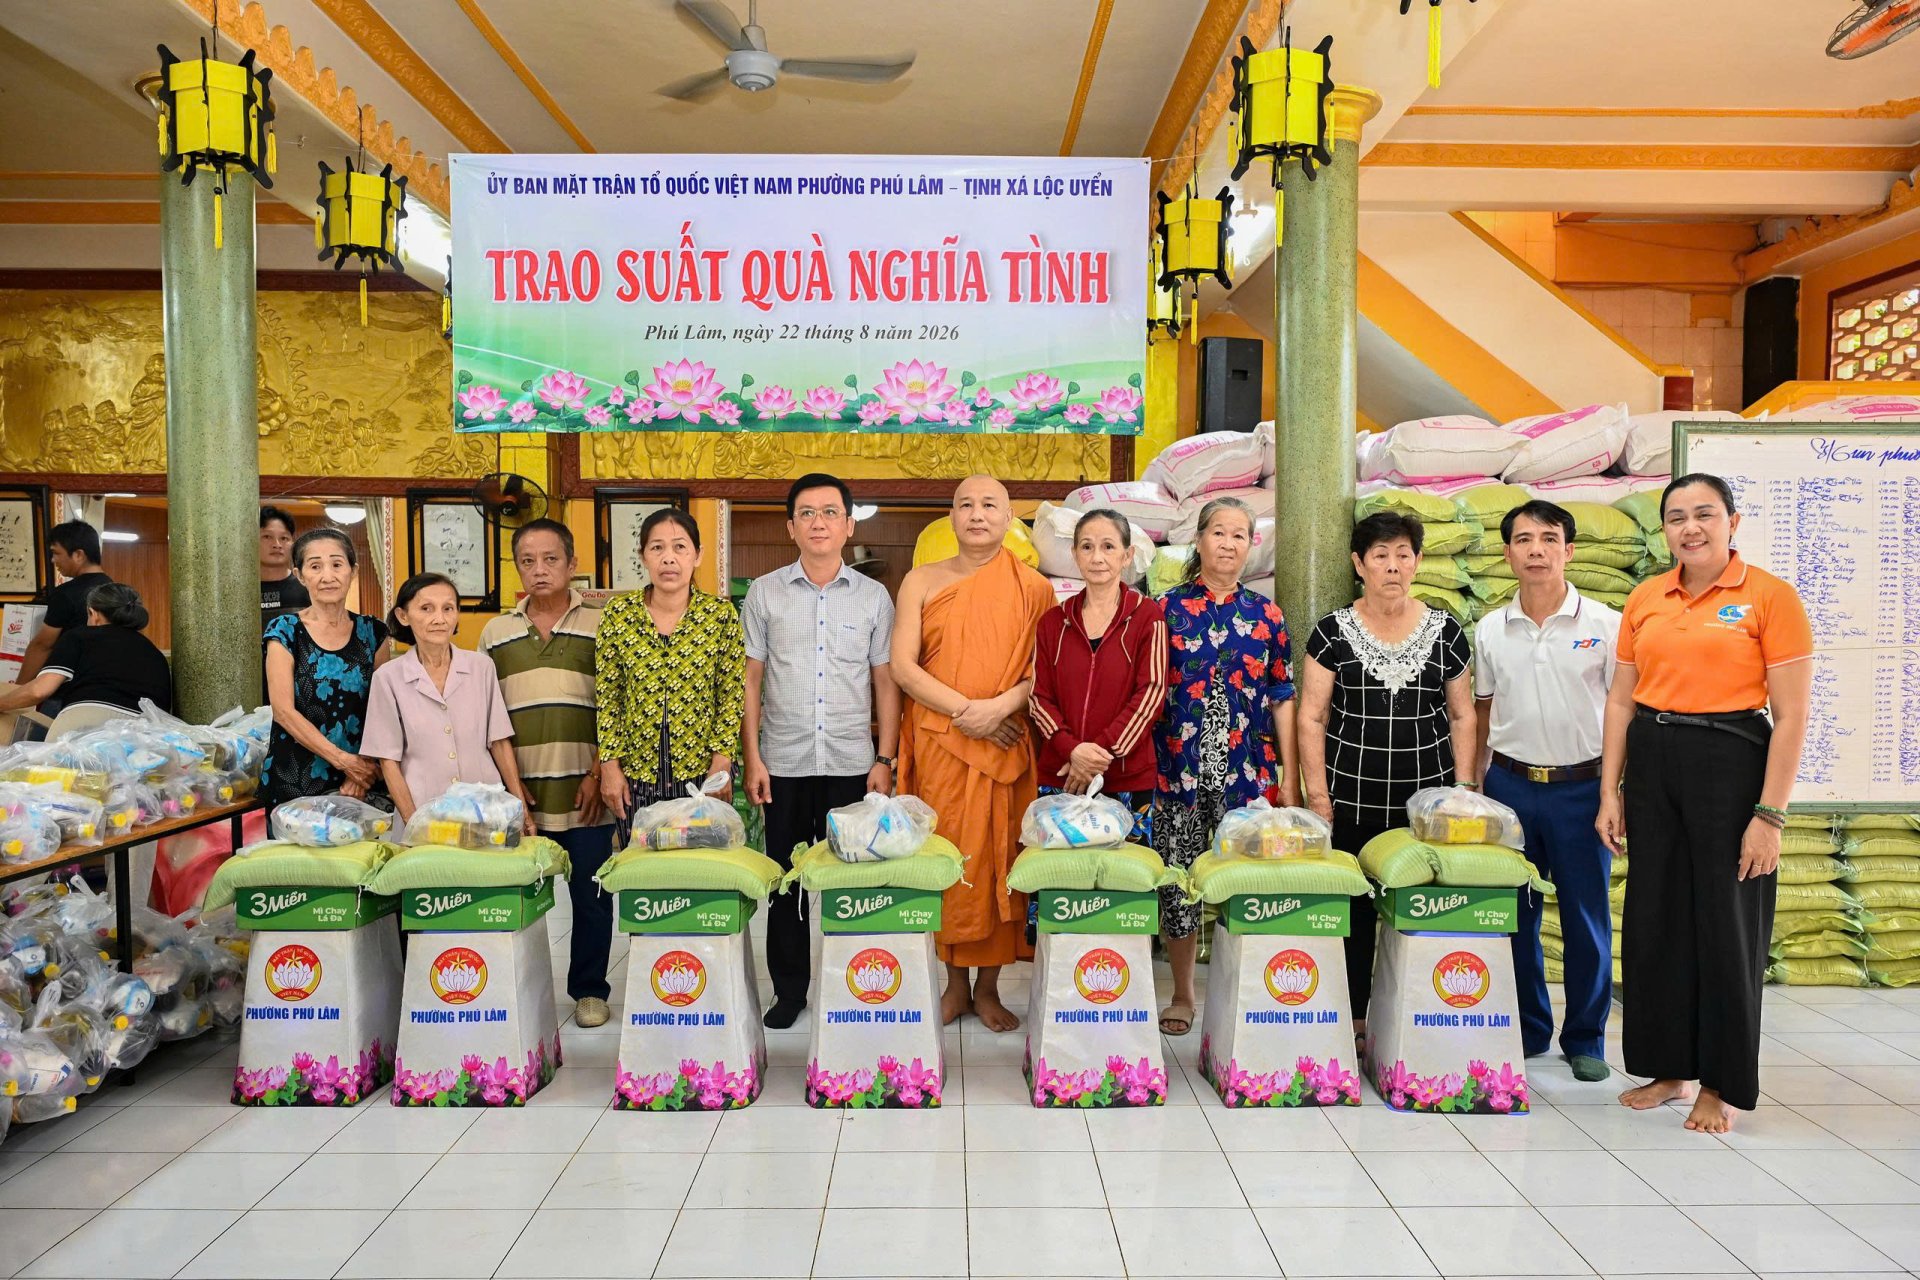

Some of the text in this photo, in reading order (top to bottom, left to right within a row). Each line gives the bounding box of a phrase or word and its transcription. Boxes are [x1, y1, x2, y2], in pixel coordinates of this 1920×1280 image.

[487, 172, 508, 195] ỦY
[514, 177, 547, 195] BAN
[553, 174, 587, 198] MẶT
[593, 174, 634, 198] TRẬN
[641, 171, 660, 194] TỔ
[665, 171, 709, 197] QUỐC
[715, 174, 748, 198] VIỆT
[754, 177, 792, 195] NAM
[798, 173, 864, 195] PHƯỜNG
[871, 174, 901, 195] PHÚ
[909, 175, 943, 195] LÂM
[964, 178, 1000, 199] TỊNH
[1007, 175, 1028, 195] XÁ
[1034, 175, 1063, 199] LỘC
[1069, 172, 1112, 197] UYỂN
[485, 220, 1110, 312] TRAO SUẤT QUÀ NGHĨA TÌNH
[644, 325, 959, 343] Phú Lâm, ngày 22 tháng 8 năm 2026
[326, 907, 347, 915] Chay
[490, 908, 512, 916] Chay
[709, 913, 731, 921] Chay
[911, 910, 933, 918] Chay
[1129, 913, 1150, 921] Chay
[1474, 910, 1509, 919] Mì Chay
[1307, 914, 1341, 923] Mì Chay
[246, 1006, 339, 1019] PHƯỜNG PHÚ LÂM
[411, 1008, 506, 1023] PHƯỜNG PHÚ LÂM
[632, 1012, 724, 1025] PHƯỜNG PHÚ LÂM
[828, 1009, 921, 1023] PHƯỜNG PHÚ LÂM
[1056, 1009, 1148, 1023] PHƯỜNG PHÚ LÂM
[1246, 1010, 1337, 1024] PHƯỜNG PHÚ LÂM
[1414, 1013, 1510, 1026] PHƯỜNG PHÚ LÂM
